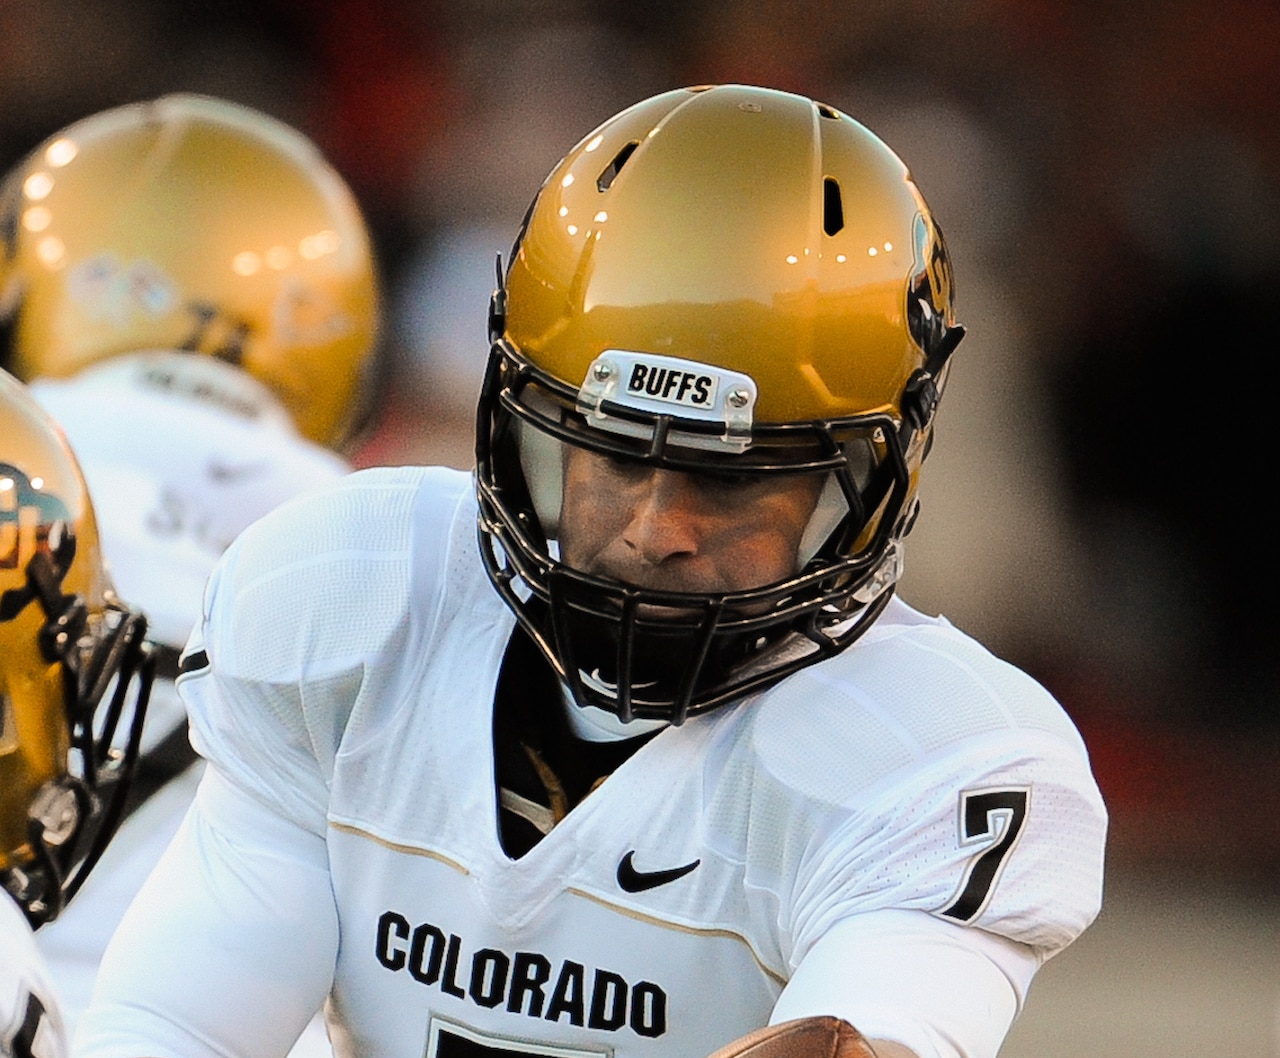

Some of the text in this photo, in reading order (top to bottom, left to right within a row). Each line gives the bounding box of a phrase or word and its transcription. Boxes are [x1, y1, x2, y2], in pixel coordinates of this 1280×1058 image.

[628, 363, 712, 404] BUFFS
[930, 785, 1033, 926] 7
[375, 911, 667, 1038] COLORADO
